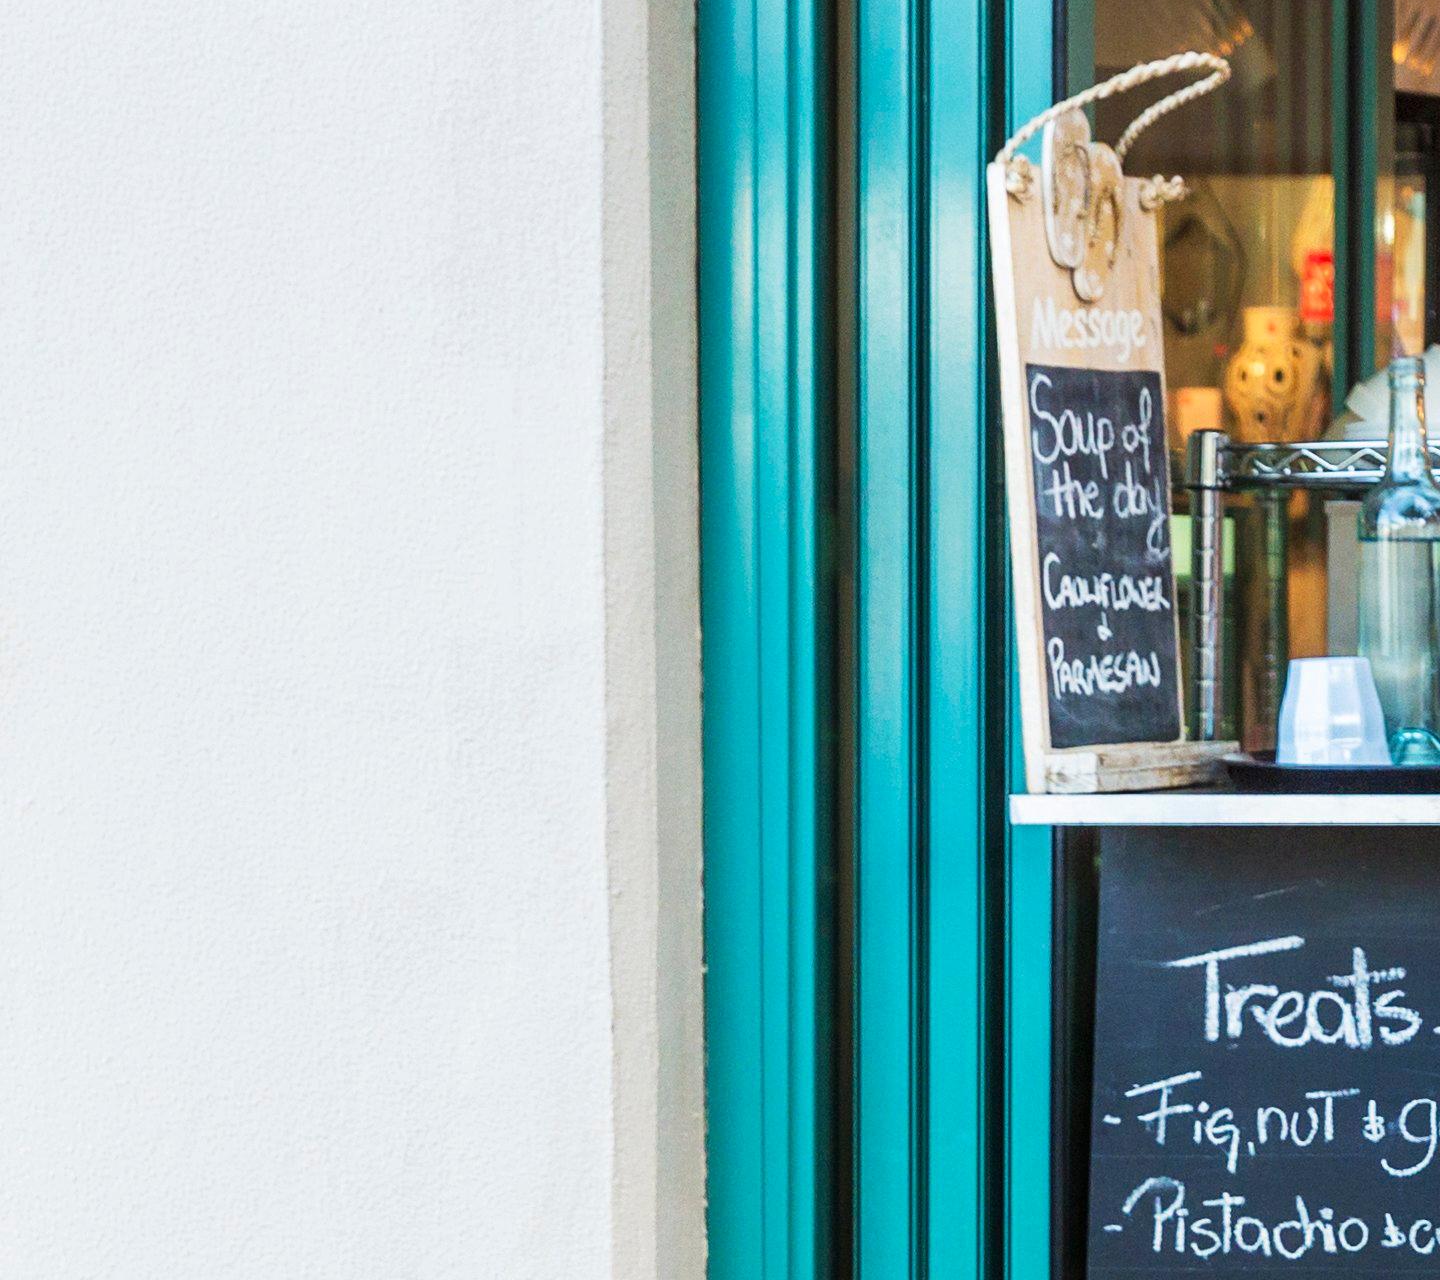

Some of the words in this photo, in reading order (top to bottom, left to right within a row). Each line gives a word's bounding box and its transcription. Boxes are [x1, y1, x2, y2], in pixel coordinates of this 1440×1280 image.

[1031, 297, 1147, 363] Message
[1031, 373, 1115, 479] Soup
[1121, 386, 1153, 473] of
[1049, 461, 1104, 520] the
[1113, 460, 1170, 560] day
[1161, 934, 1423, 1050] Treats
